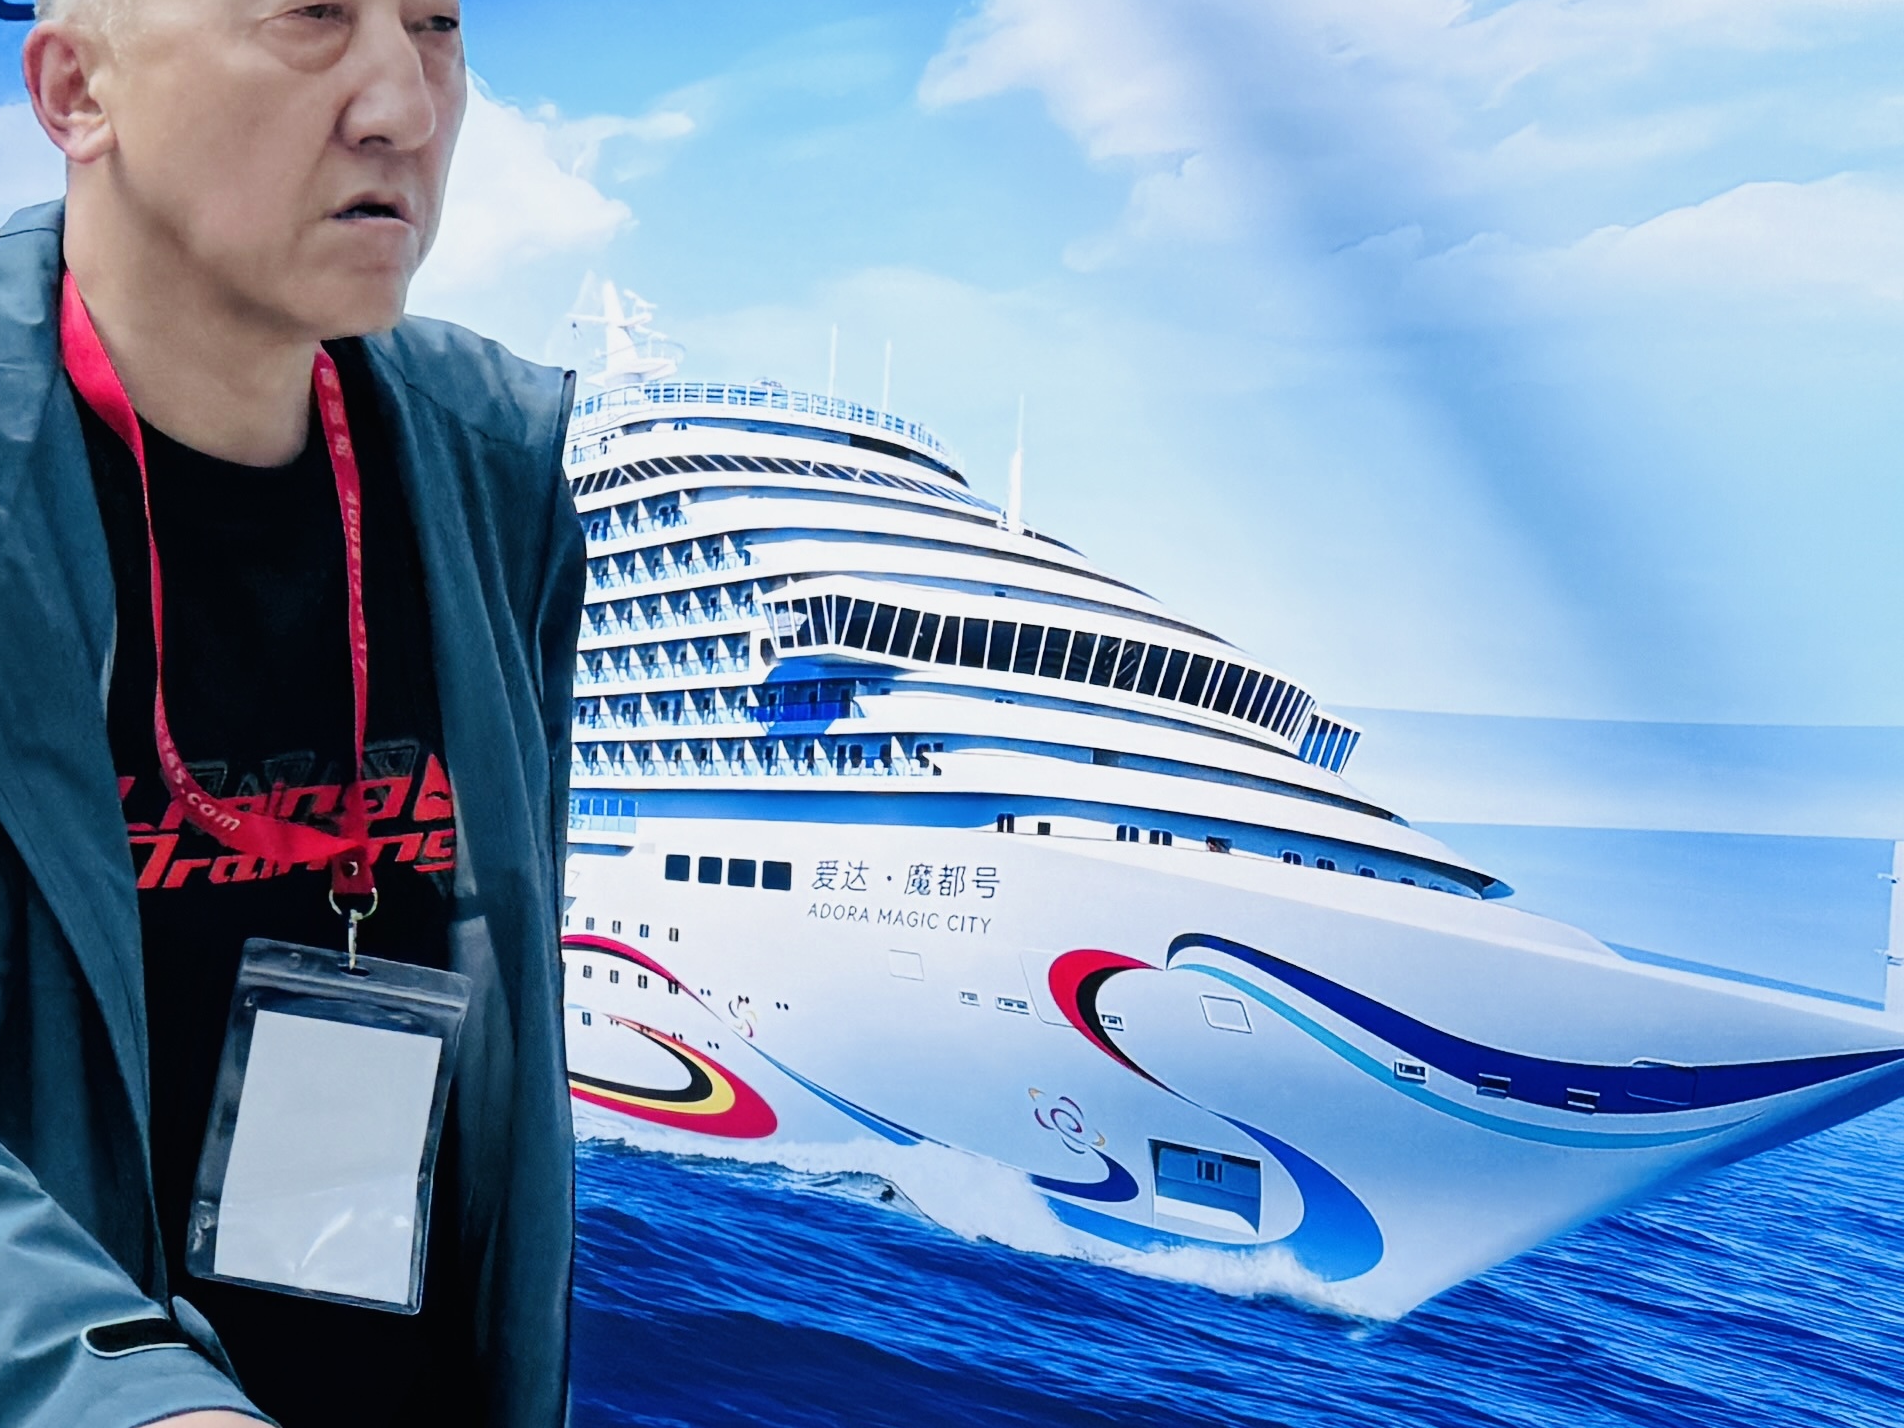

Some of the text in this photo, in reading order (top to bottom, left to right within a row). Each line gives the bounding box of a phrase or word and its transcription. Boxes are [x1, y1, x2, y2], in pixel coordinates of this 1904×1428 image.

[806, 902, 993, 935] ADORA MAGIC CITY
